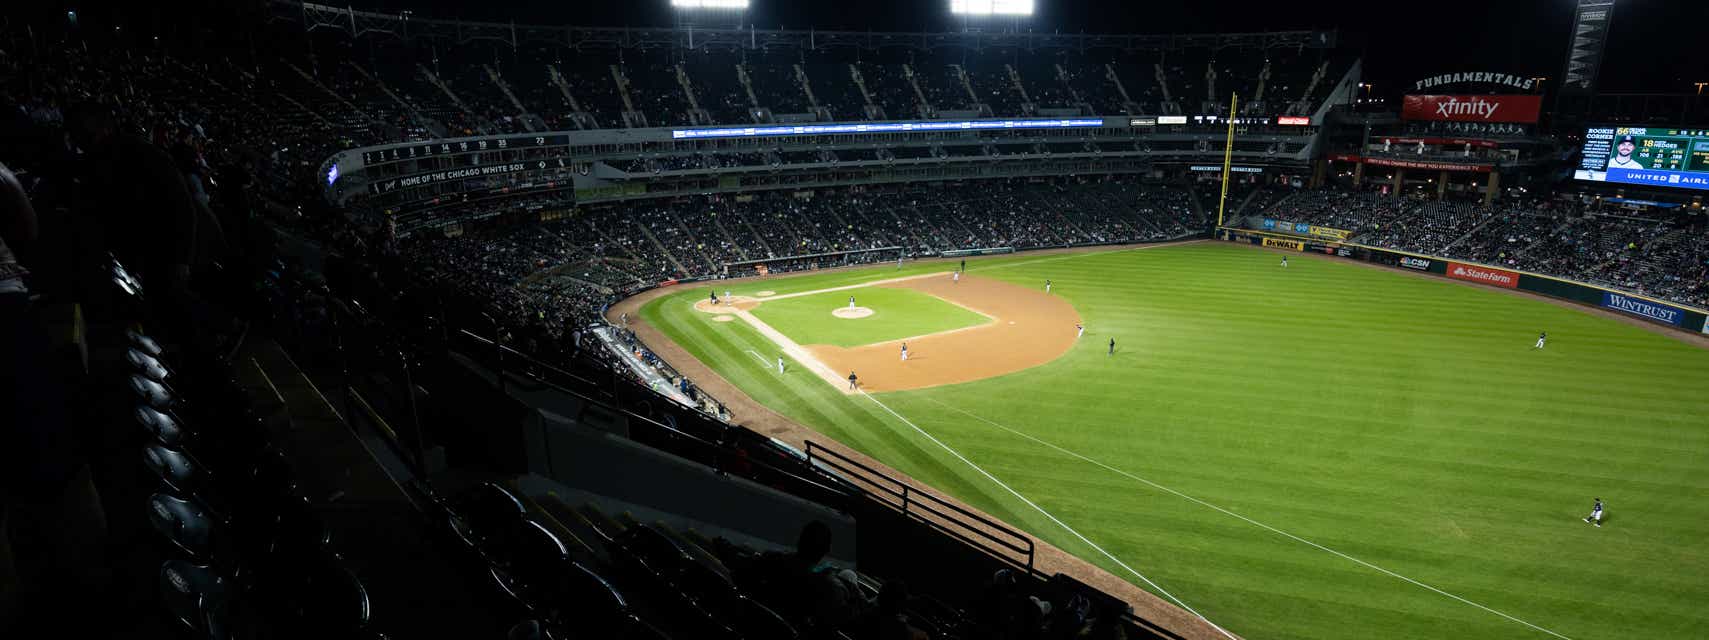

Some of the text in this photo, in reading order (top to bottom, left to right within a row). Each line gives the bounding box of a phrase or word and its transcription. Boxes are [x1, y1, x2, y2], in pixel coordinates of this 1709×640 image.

[1416, 72, 1533, 90] FUNDAMENTALS
[1436, 97, 1500, 118] xfinity
[401, 177, 421, 186] HOME
[431, 172, 446, 181] THE
[447, 168, 480, 179] CHICAGO
[482, 165, 508, 175] WHITE
[509, 163, 525, 171] SOX
[1627, 173, 1667, 181] UNITED
[1411, 258, 1430, 268] CSN
[1610, 294, 1677, 320] WINTRUST
